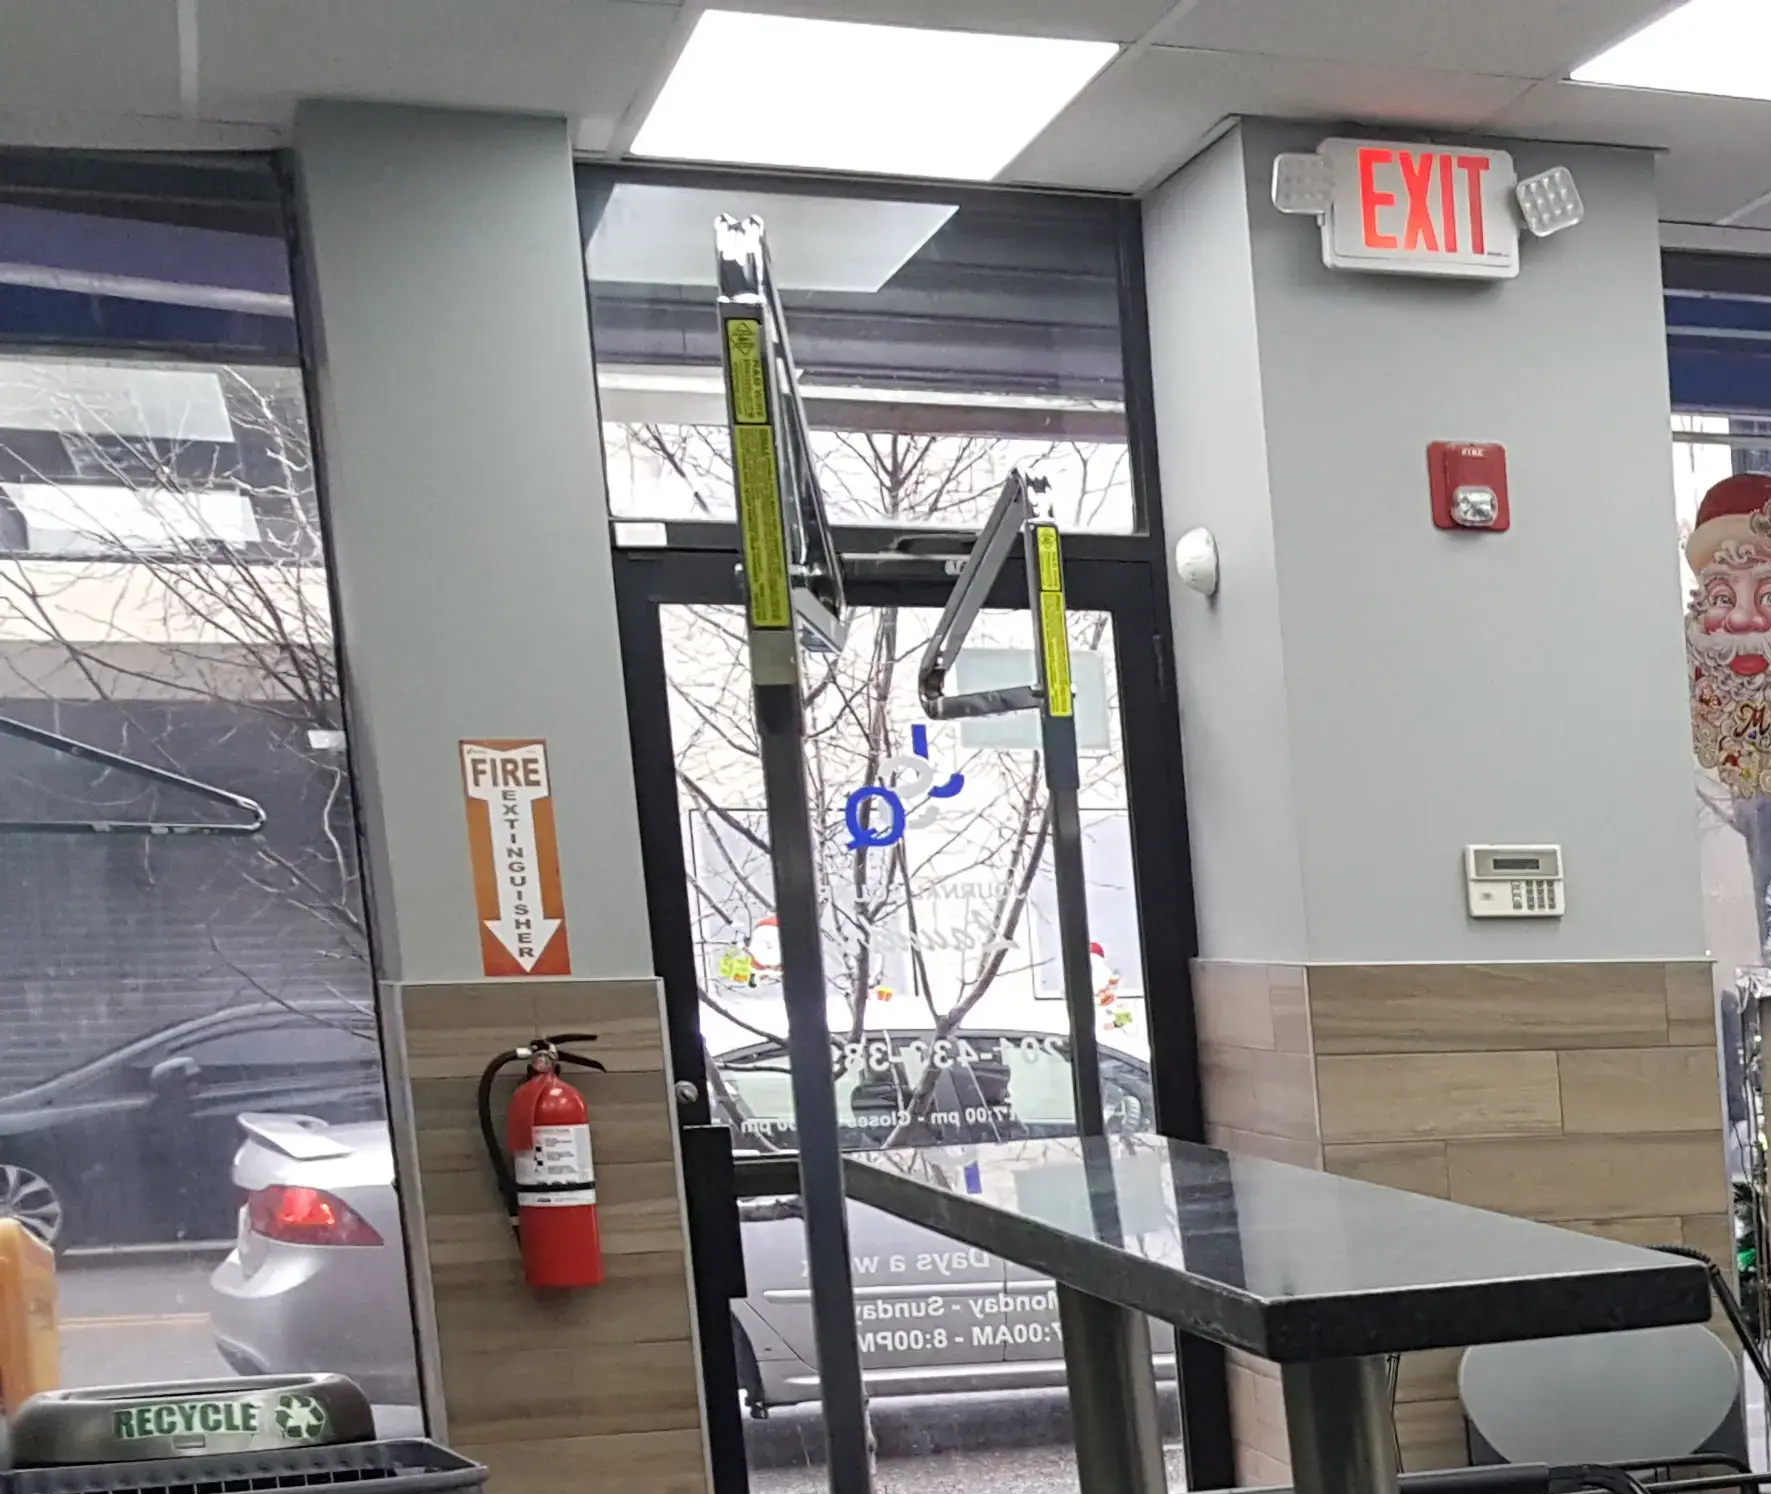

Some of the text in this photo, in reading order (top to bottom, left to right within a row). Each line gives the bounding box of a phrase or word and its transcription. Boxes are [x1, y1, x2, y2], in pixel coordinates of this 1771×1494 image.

[1357, 148, 1490, 255] EXIT
[471, 757, 541, 787] FIRE
[502, 790, 534, 958] EXTINGUISHER
[113, 1401, 260, 1437] RECYCLE
